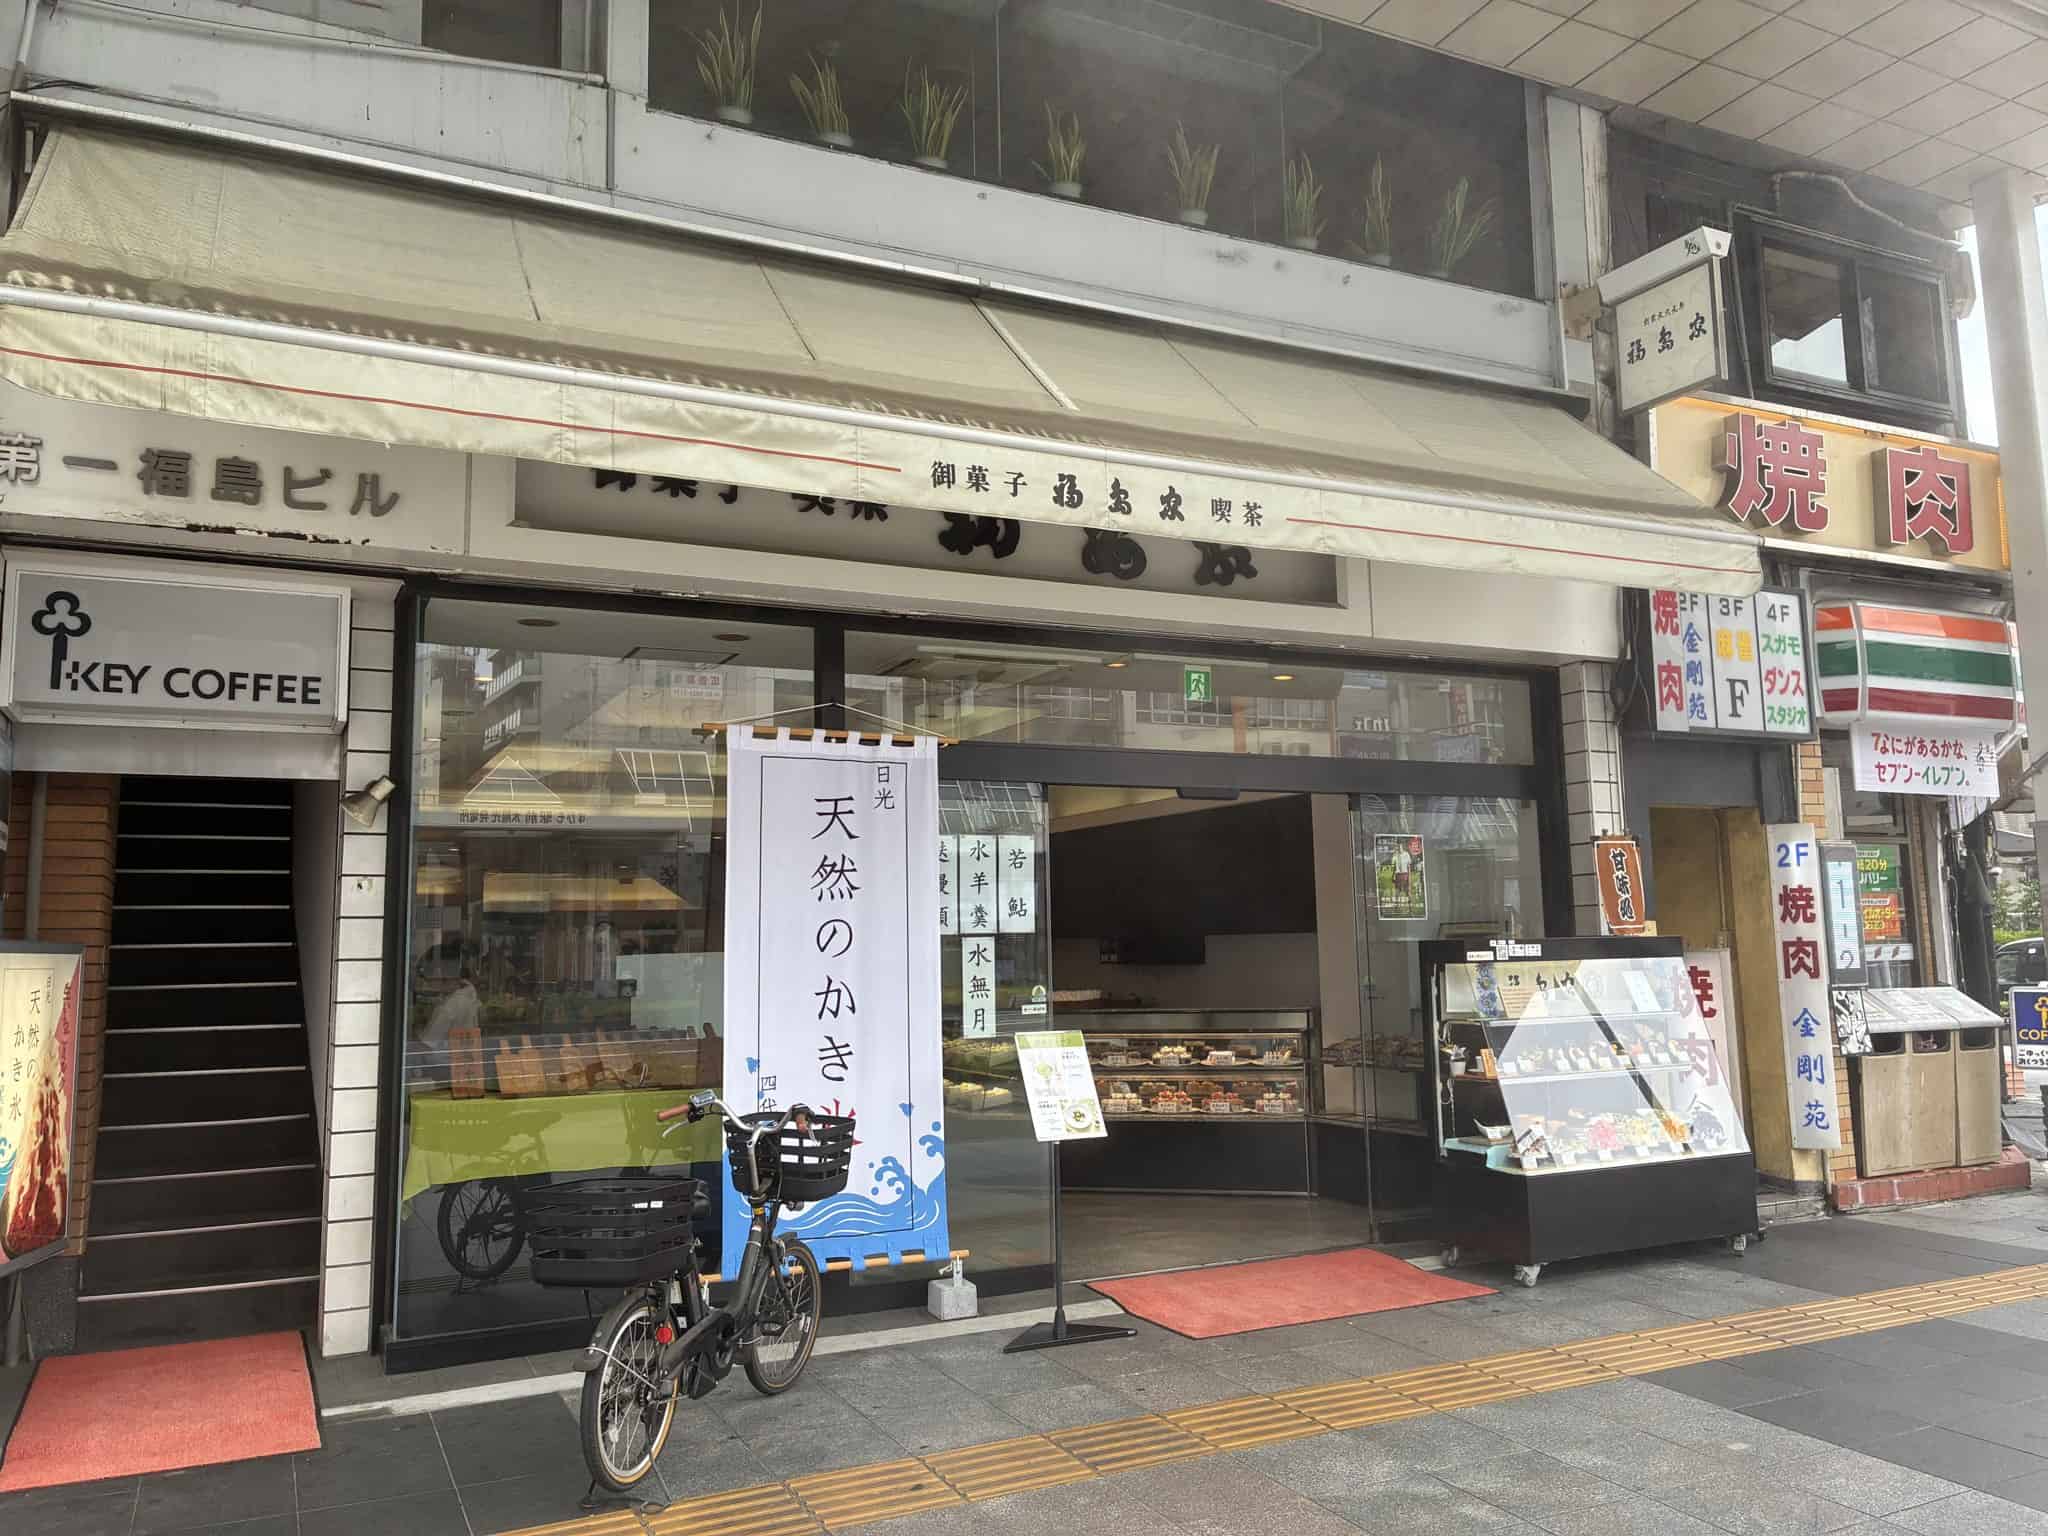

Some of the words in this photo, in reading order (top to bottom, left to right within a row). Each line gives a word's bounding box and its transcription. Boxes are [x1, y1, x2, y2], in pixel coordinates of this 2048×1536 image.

[0, 432, 400, 518] 第一福島ビル
[930, 461, 1028, 498] 御菓子
[1210, 496, 1264, 527] 喫茶
[1723, 413, 1975, 554] 焼肉
[1719, 597, 1744, 616] 3F
[1766, 604, 1790, 622] 4F
[1653, 590, 1684, 711] 焼肉
[1682, 622, 1708, 721] 金剛苑
[1761, 634, 1801, 656] スガモ
[65, 661, 152, 695] KEY
[163, 667, 322, 705] COFFEE
[1725, 678, 1749, 718] F
[1764, 667, 1805, 696] ダンス
[1766, 706, 1807, 726] スタジオ
[874, 766, 896, 811] 日光
[969, 839, 991, 929] 水羊羹
[1007, 848, 1028, 918] 若鮎
[1776, 843, 1809, 868] 2F
[1778, 885, 1822, 980] 焼肉
[967, 943, 992, 1031] 水無月
[26, 989, 41, 1081] 天然の
[1792, 1007, 1831, 1131] 金剛苑
[2018, 1048, 2048, 1057] ごゆっく
[9, 1022, 25, 1121] かき氷
